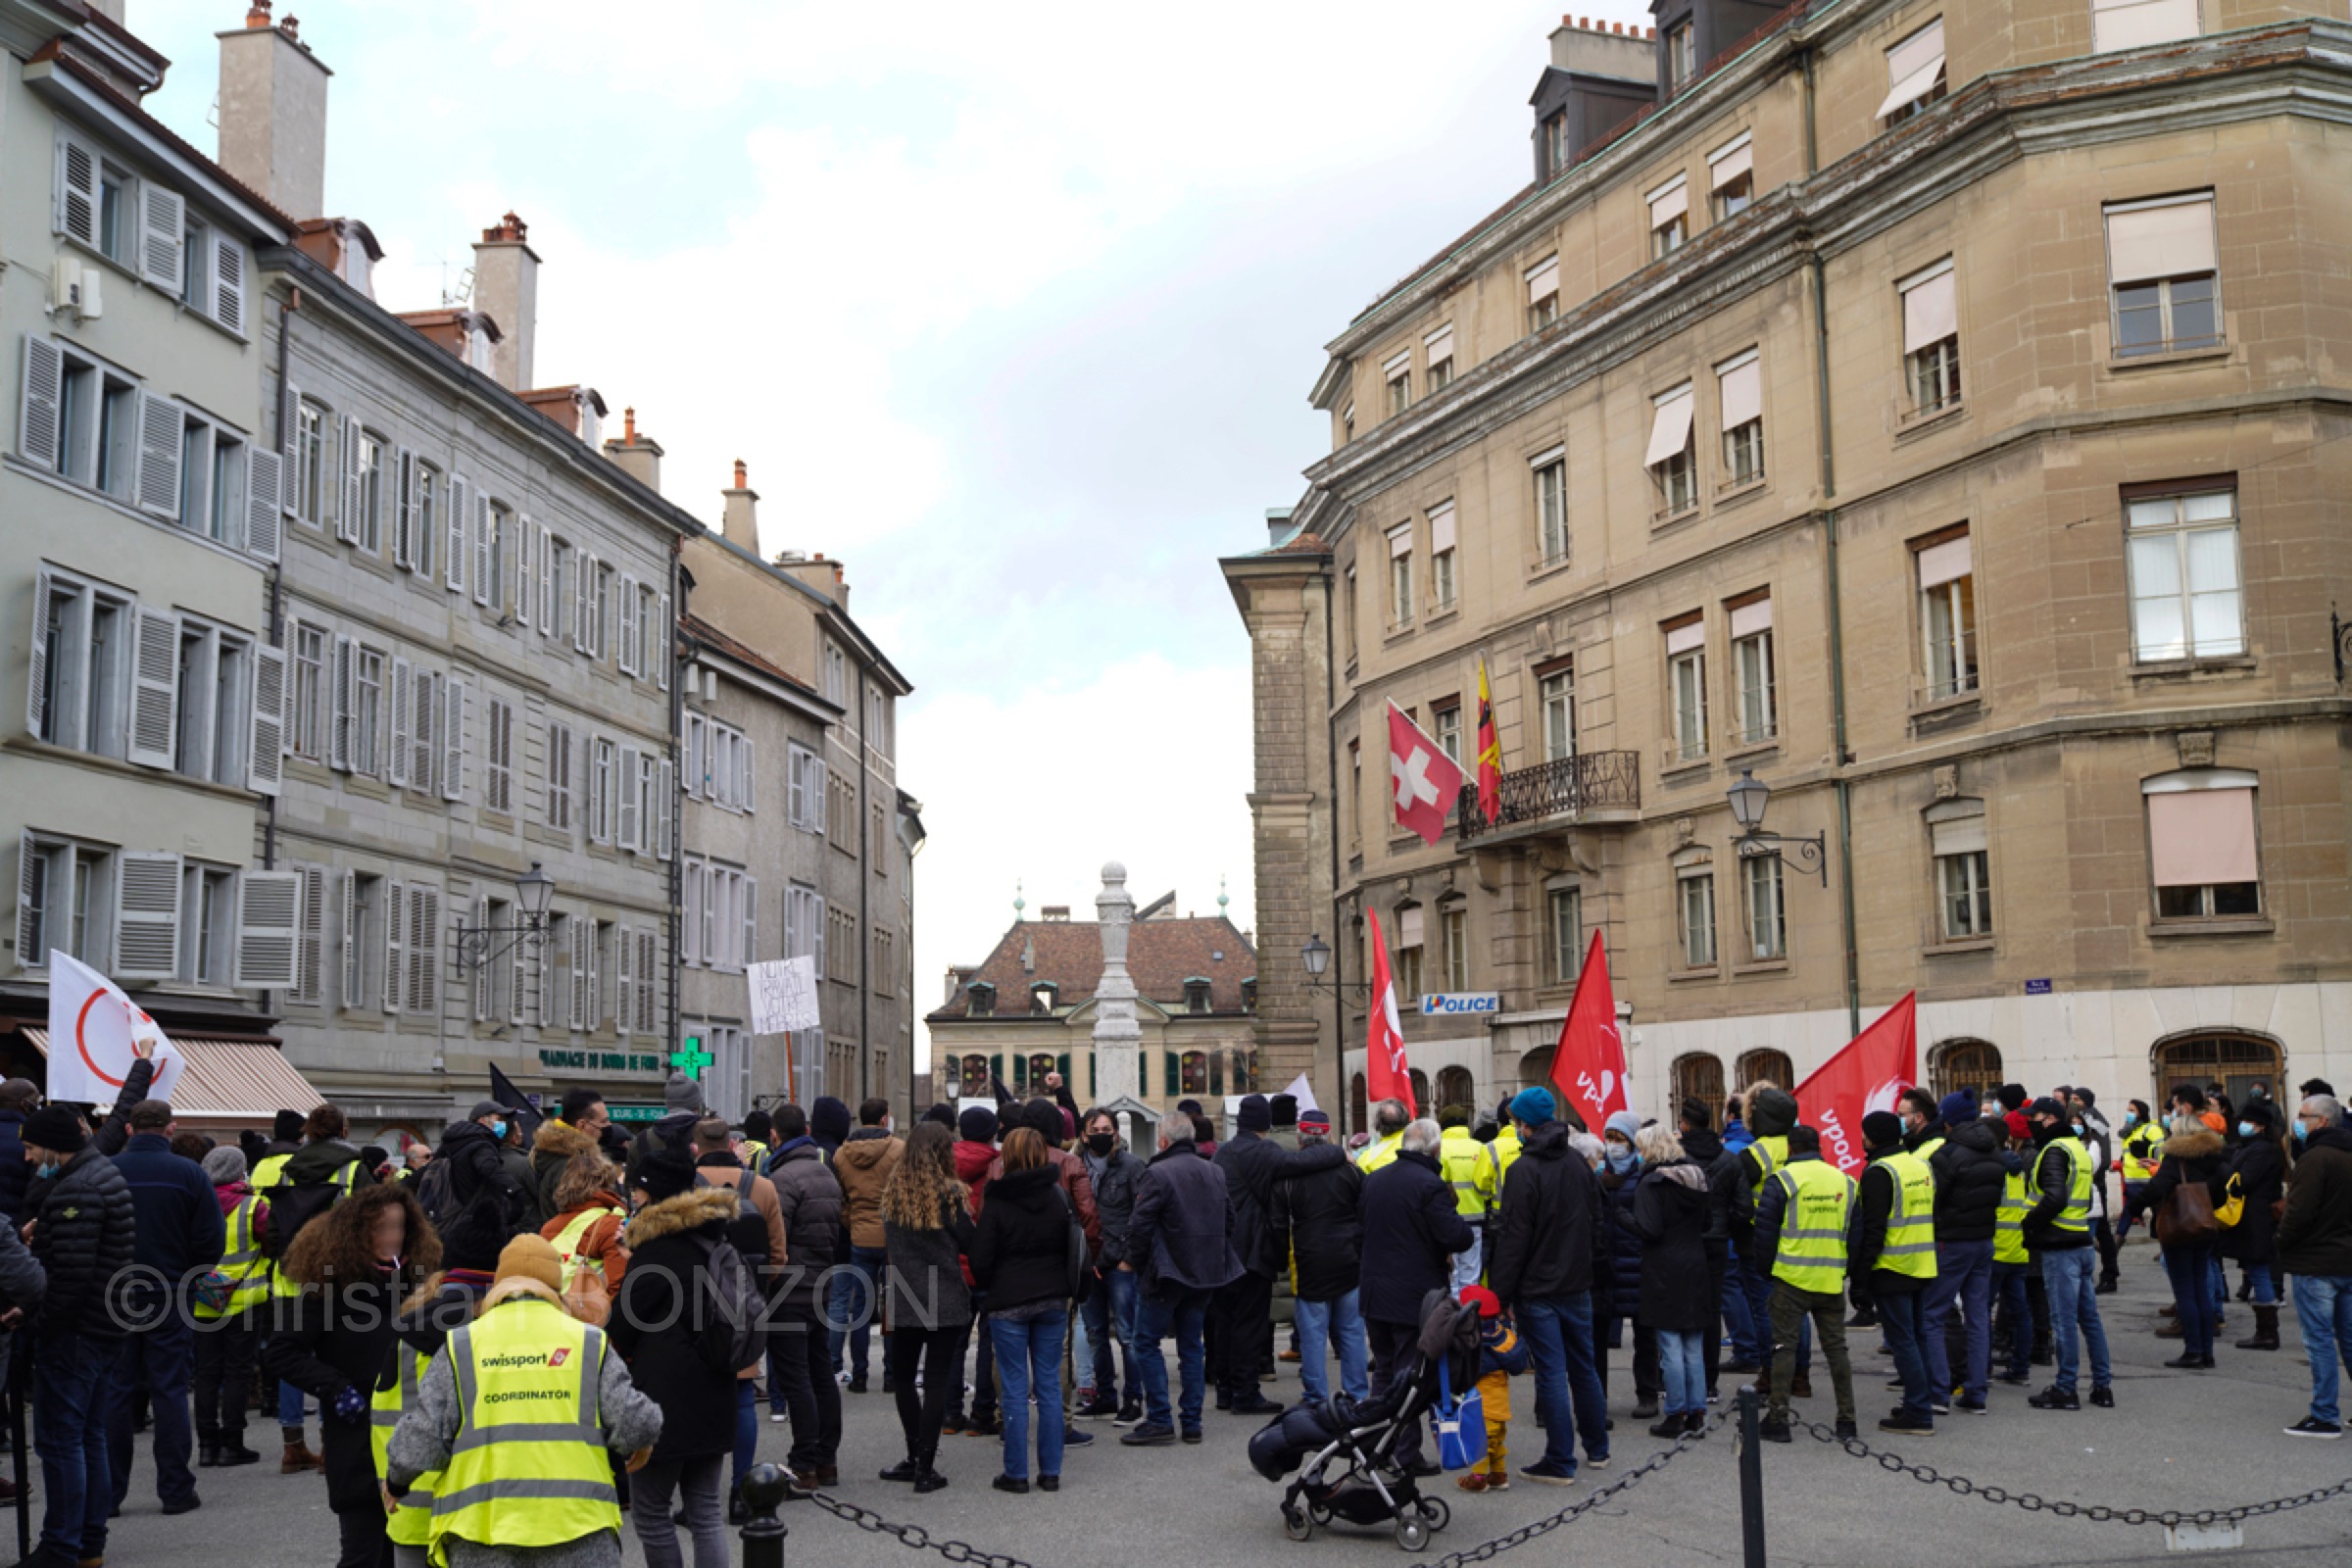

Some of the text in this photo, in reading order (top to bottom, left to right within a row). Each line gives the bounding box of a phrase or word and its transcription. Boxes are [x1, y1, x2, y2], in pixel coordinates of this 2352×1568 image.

[1425, 995, 1495, 1012] POLICE
[1820, 1108, 1861, 1170] vpod
[481, 1352, 548, 1368] swissport
[483, 1389, 571, 1404] COORDINATOR
